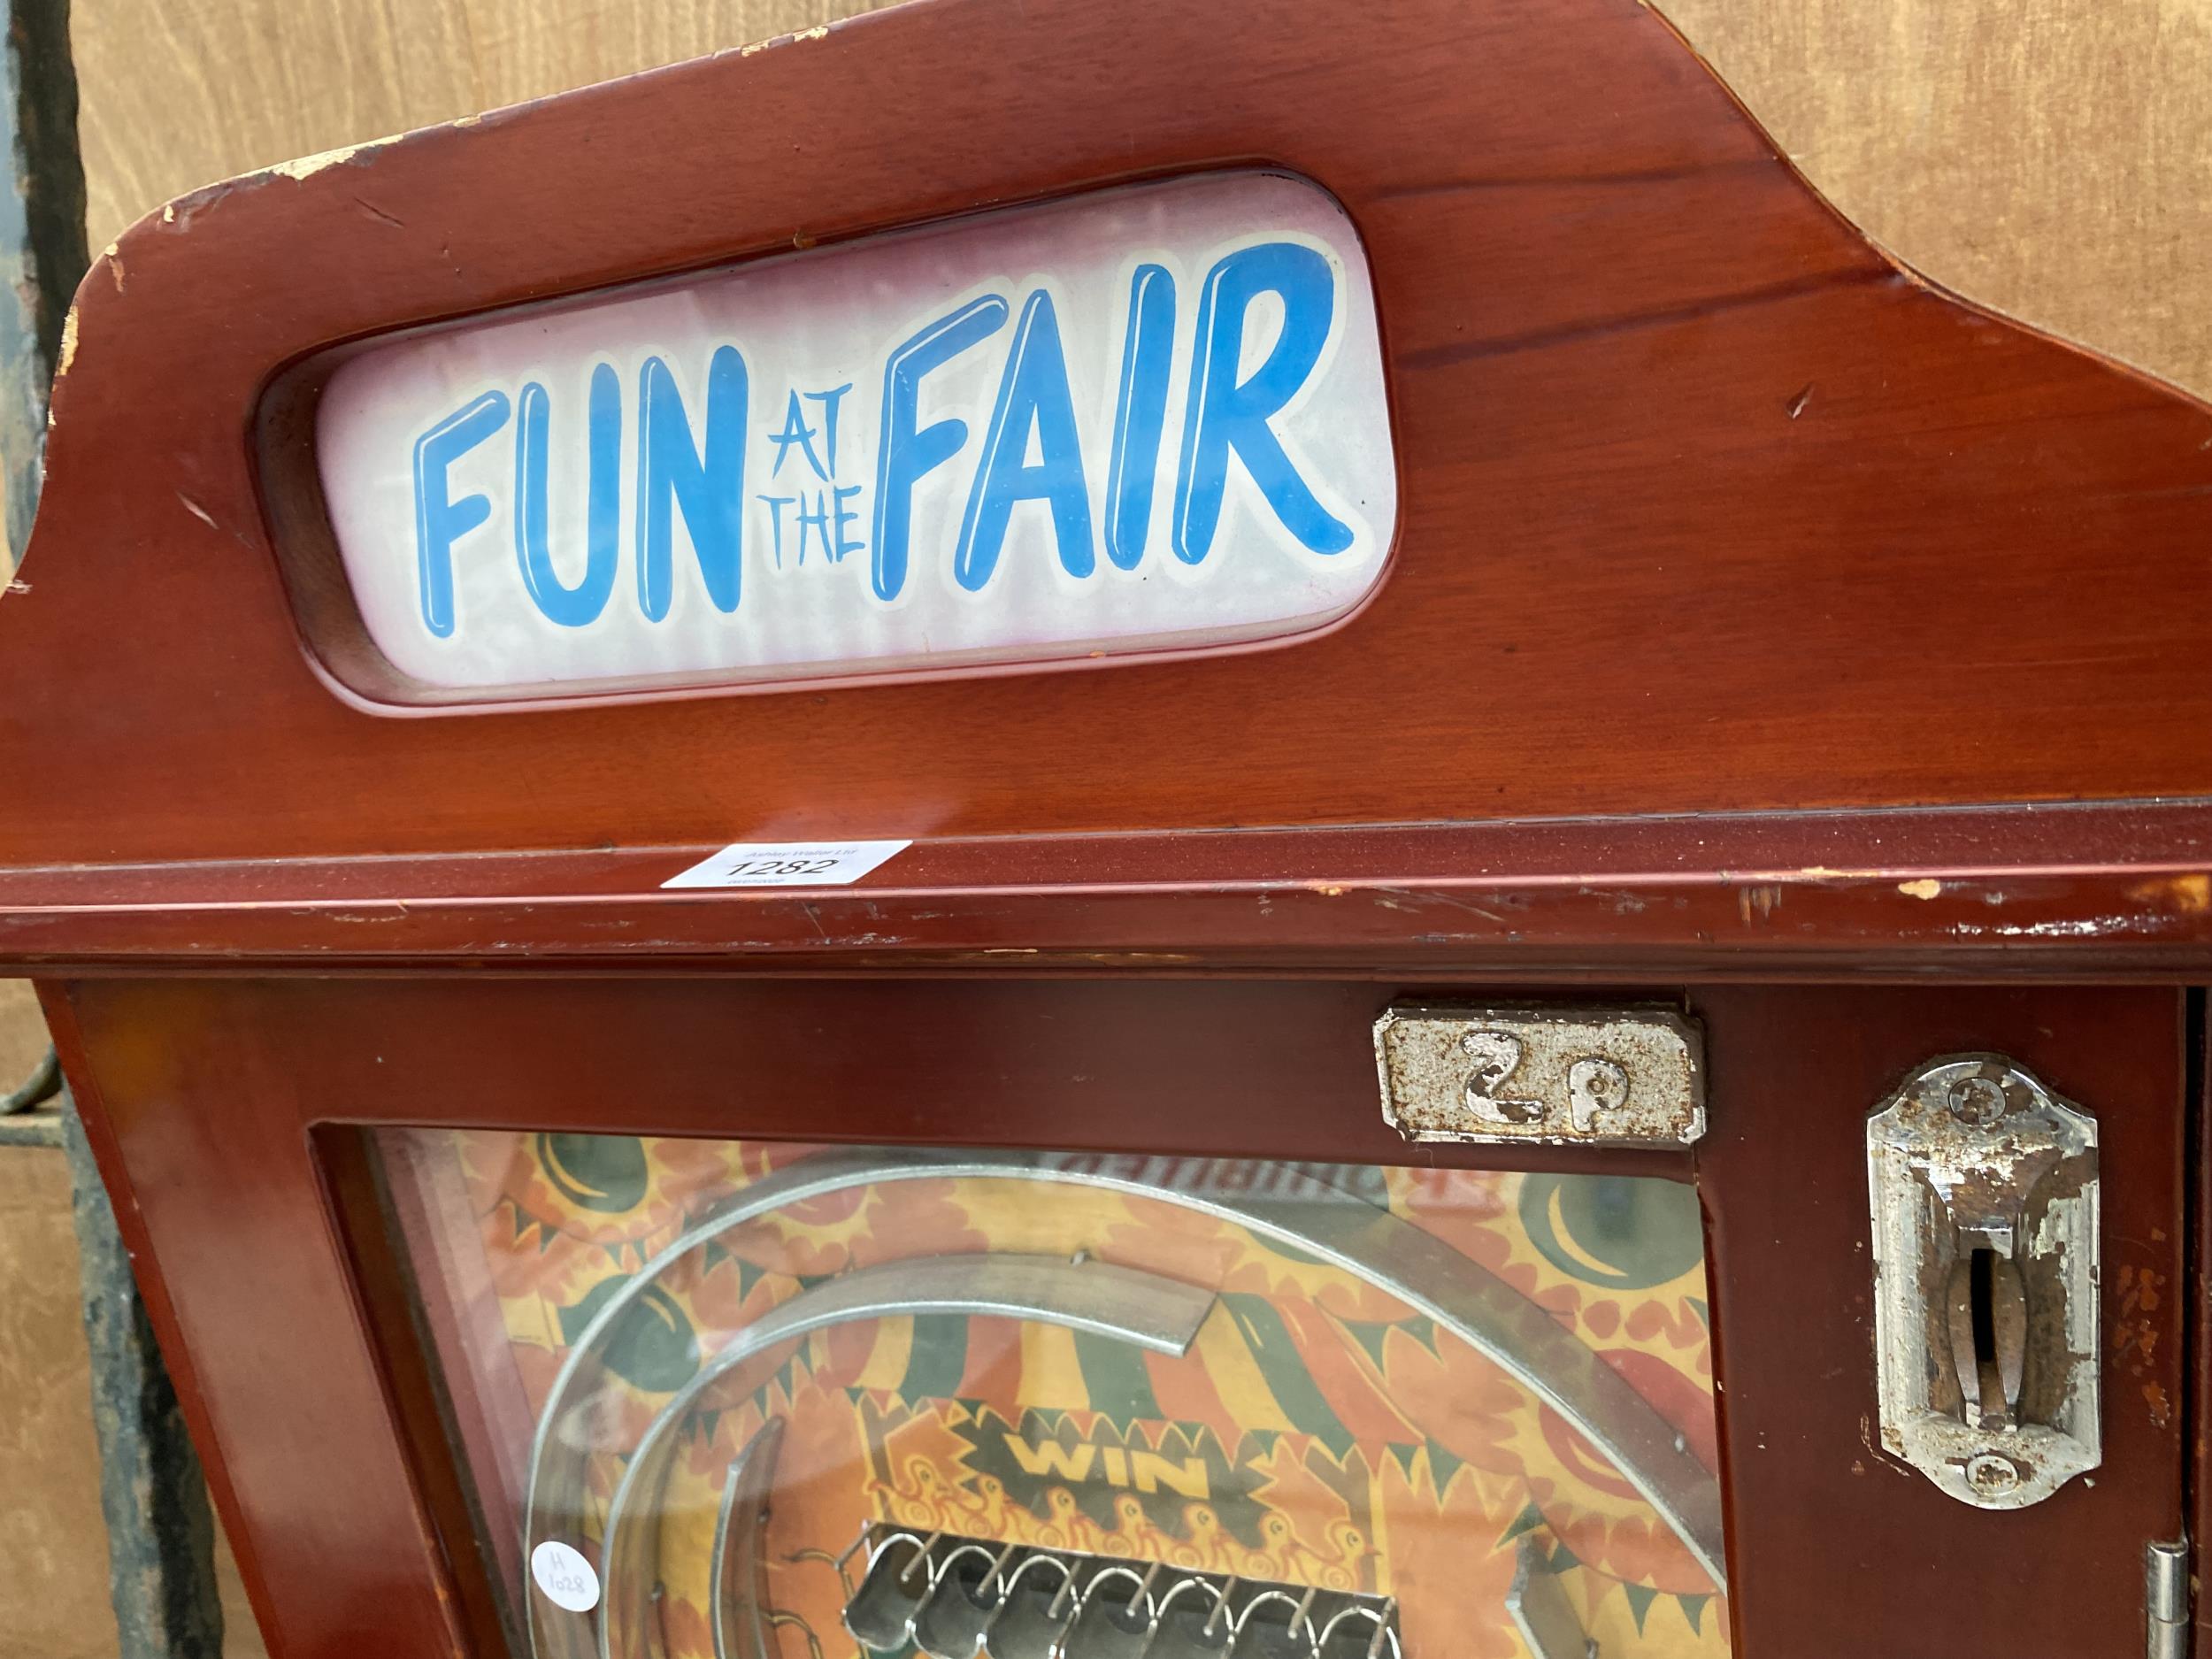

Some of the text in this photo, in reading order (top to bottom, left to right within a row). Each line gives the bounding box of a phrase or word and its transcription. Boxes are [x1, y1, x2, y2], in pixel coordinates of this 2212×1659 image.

[767, 382, 853, 482] AT
[872, 242, 1355, 602] FAIR
[413, 345, 749, 639] FUN
[756, 485, 865, 571] THE
[726, 859, 840, 876] 1282
[1002, 1432, 1210, 1500] WIN
[549, 1574, 586, 1594] 1028
